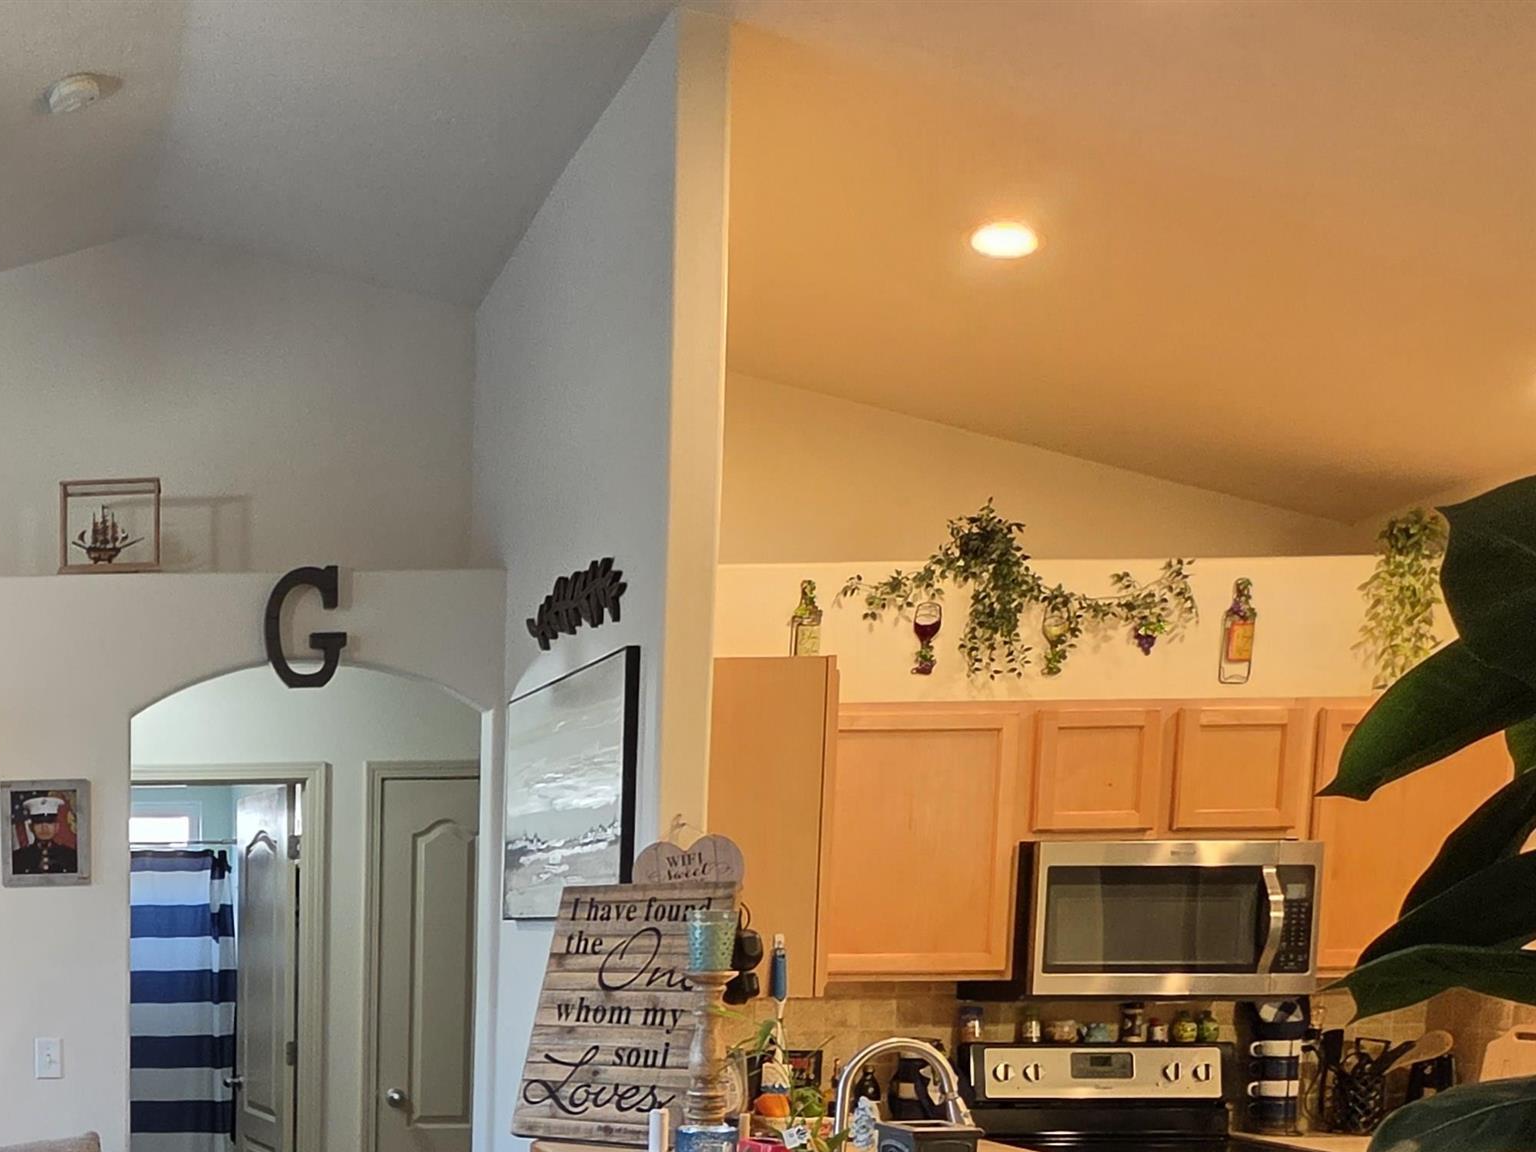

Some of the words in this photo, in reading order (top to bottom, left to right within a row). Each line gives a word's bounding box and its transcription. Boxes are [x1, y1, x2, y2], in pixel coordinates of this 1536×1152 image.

[265, 565, 347, 688] G
[666, 852, 703, 867] WIFI
[570, 897, 581, 921] I
[586, 897, 639, 922] have
[565, 931, 603, 955] the
[557, 997, 632, 1025] whom
[642, 1007, 684, 1034] my
[611, 1042, 670, 1069] soul
[523, 1045, 676, 1115] Loves
